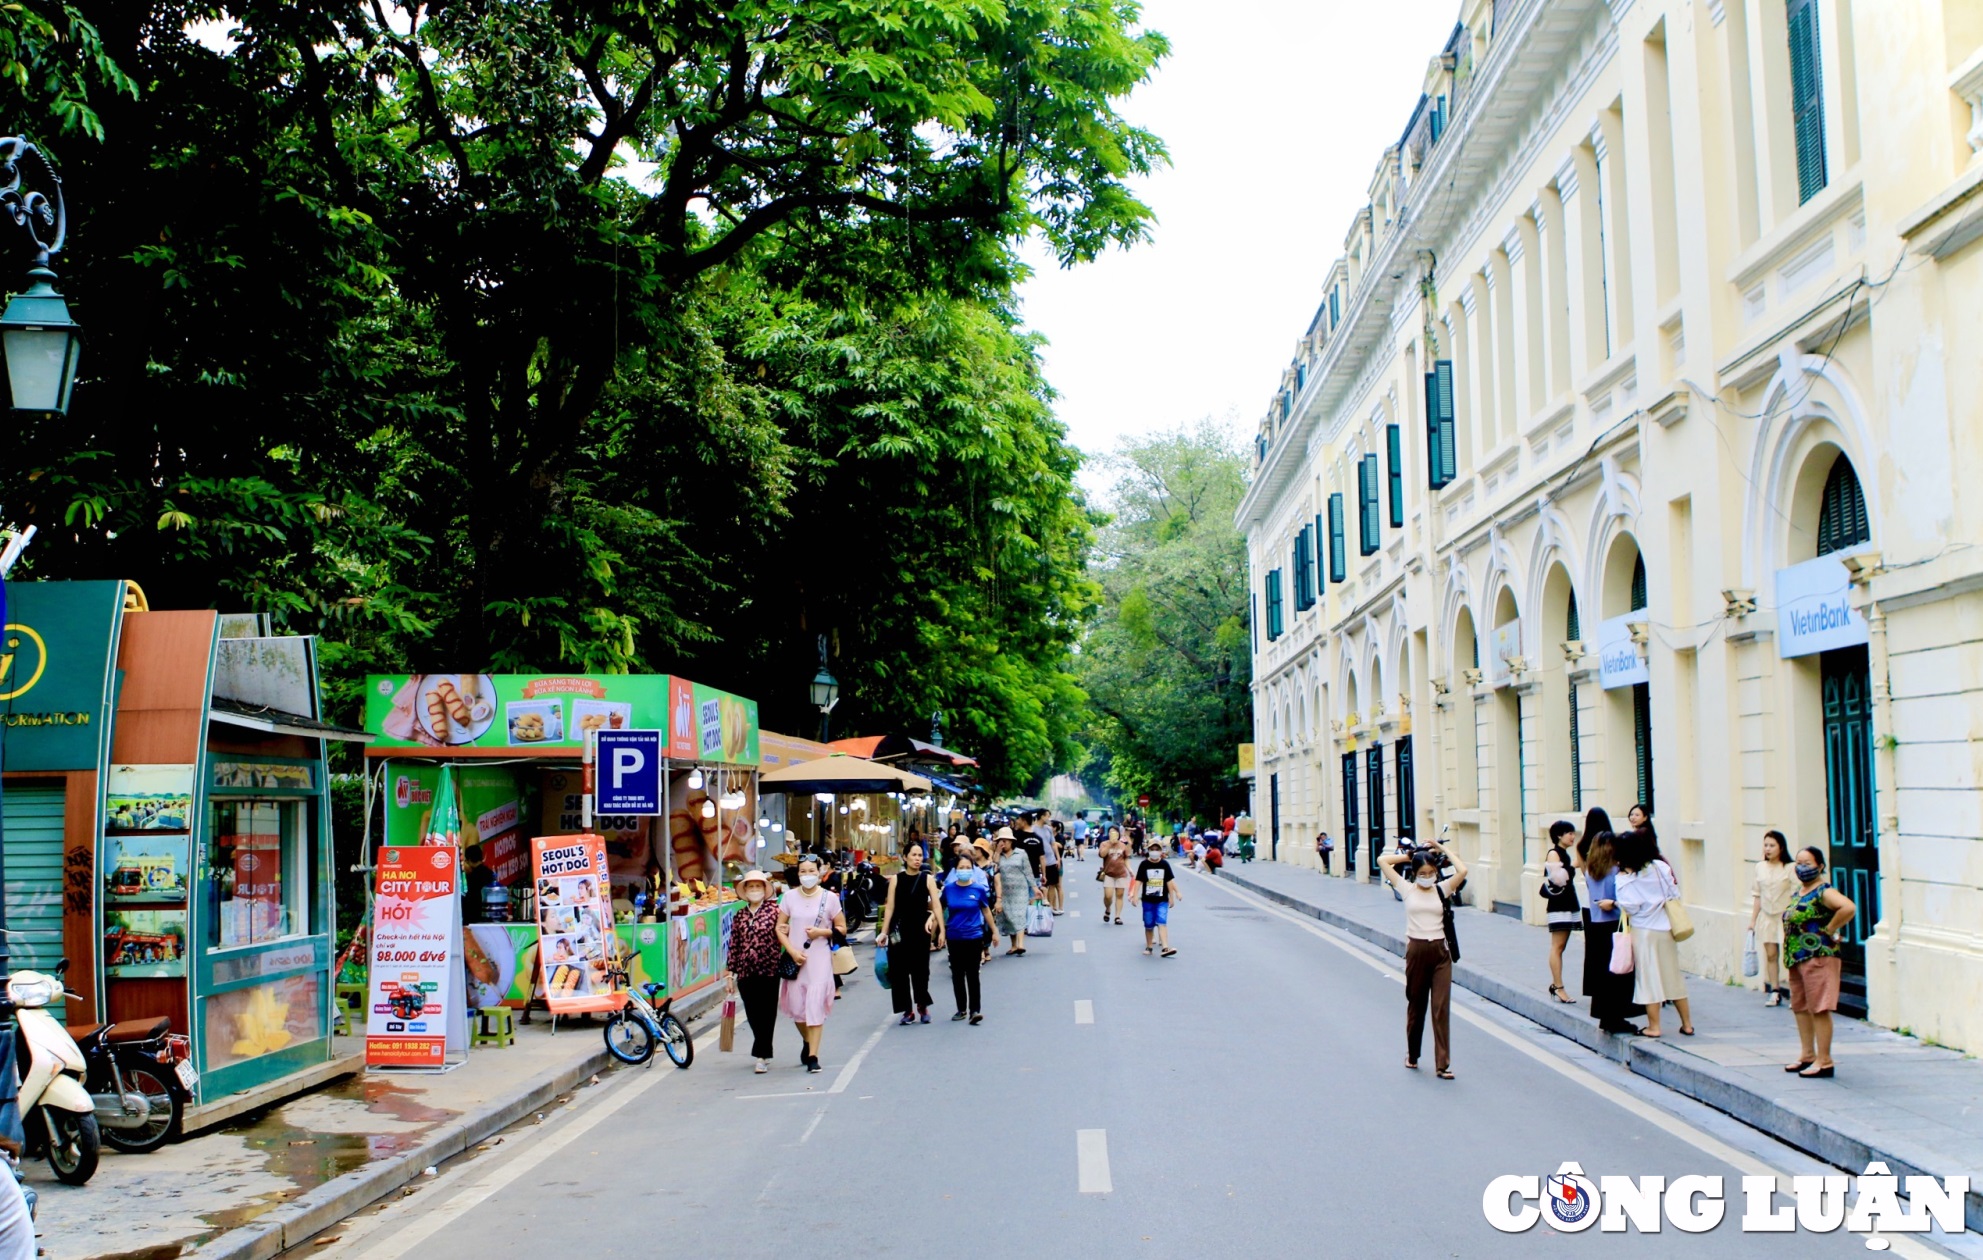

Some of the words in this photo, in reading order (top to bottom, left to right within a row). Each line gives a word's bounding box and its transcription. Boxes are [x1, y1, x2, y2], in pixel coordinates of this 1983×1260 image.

[1790, 598, 1851, 636] VietinBank
[1602, 650, 1638, 674] VietinBank
[612, 747, 645, 789] P
[561, 815, 595, 830] HO
[601, 815, 638, 830] DOG
[542, 846, 584, 862] SEOUL'S
[541, 863, 564, 875] HOT
[566, 858, 589, 871] DOG
[382, 871, 397, 879] HA
[399, 871, 417, 879] NOI
[380, 881, 411, 893] CITY
[415, 881, 450, 893] TOUR
[381, 903, 412, 920] HÓT
[377, 951, 416, 962] 98.000
[419, 950, 446, 962] đ/vé
